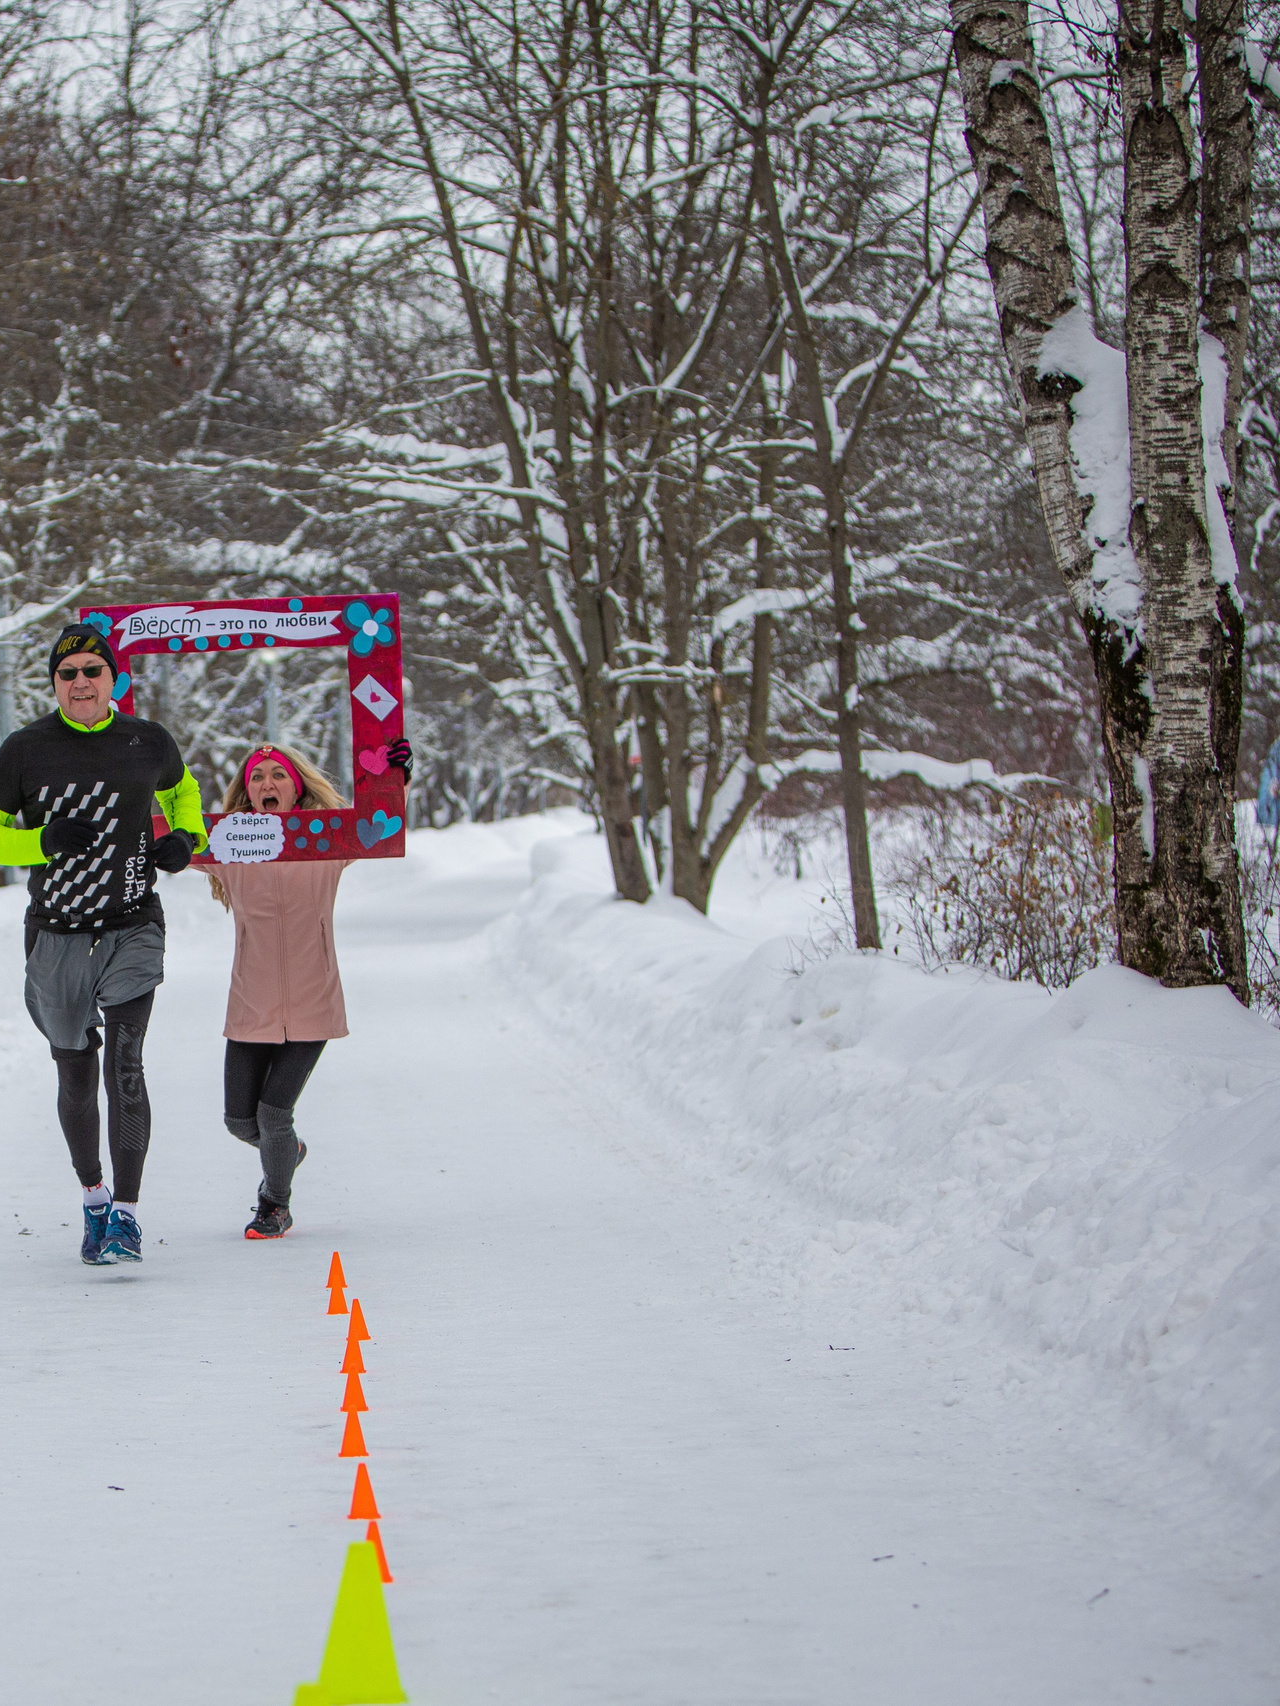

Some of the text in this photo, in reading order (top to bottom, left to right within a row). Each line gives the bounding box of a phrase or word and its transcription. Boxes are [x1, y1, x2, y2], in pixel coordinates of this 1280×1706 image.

[220, 619, 244, 630] это
[249, 618, 267, 629] по
[275, 613, 327, 628] любви
[232, 816, 270, 827] 5 вёрст
[226, 832, 276, 842] Северное
[231, 848, 271, 859] Тушино
